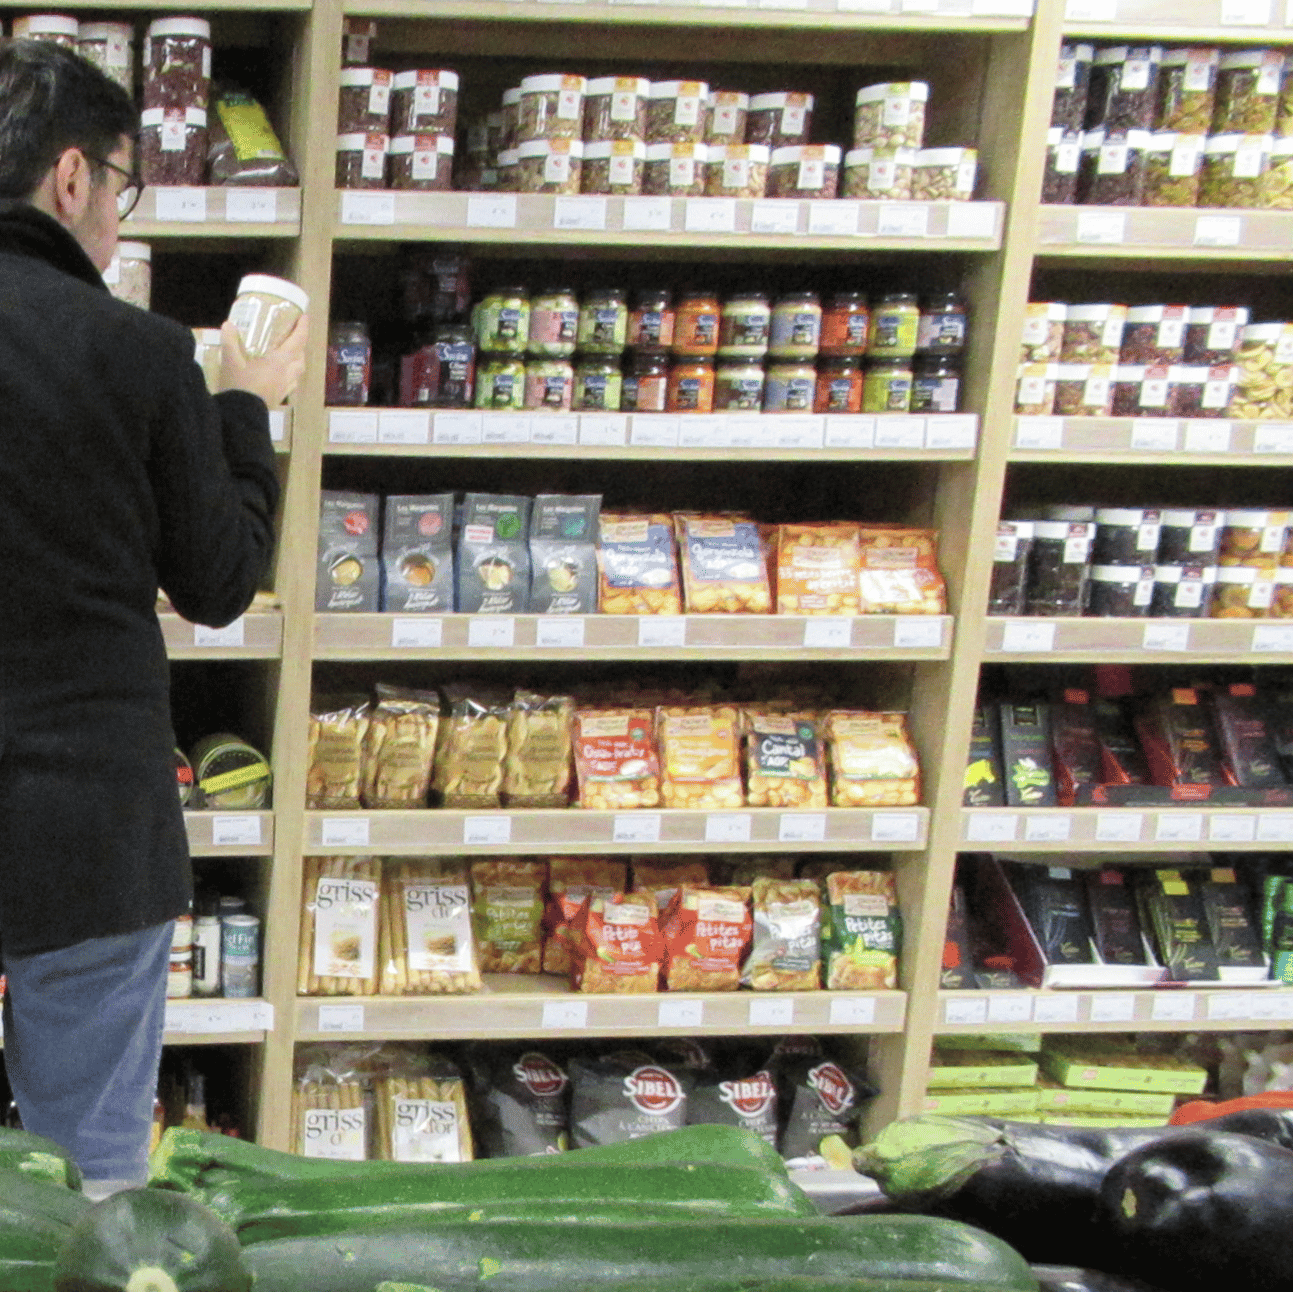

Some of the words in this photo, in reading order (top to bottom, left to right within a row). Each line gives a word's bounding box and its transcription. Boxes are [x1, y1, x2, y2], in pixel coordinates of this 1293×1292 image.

[761, 739, 806, 758] Cantal
[317, 882, 374, 909] griss
[407, 886, 467, 911] griss
[511, 1064, 569, 1085] SIBELL
[621, 1076, 686, 1099] SIBELL
[718, 1081, 777, 1102] SIBELL
[305, 1110, 363, 1139] griss
[396, 1101, 455, 1127] griss
